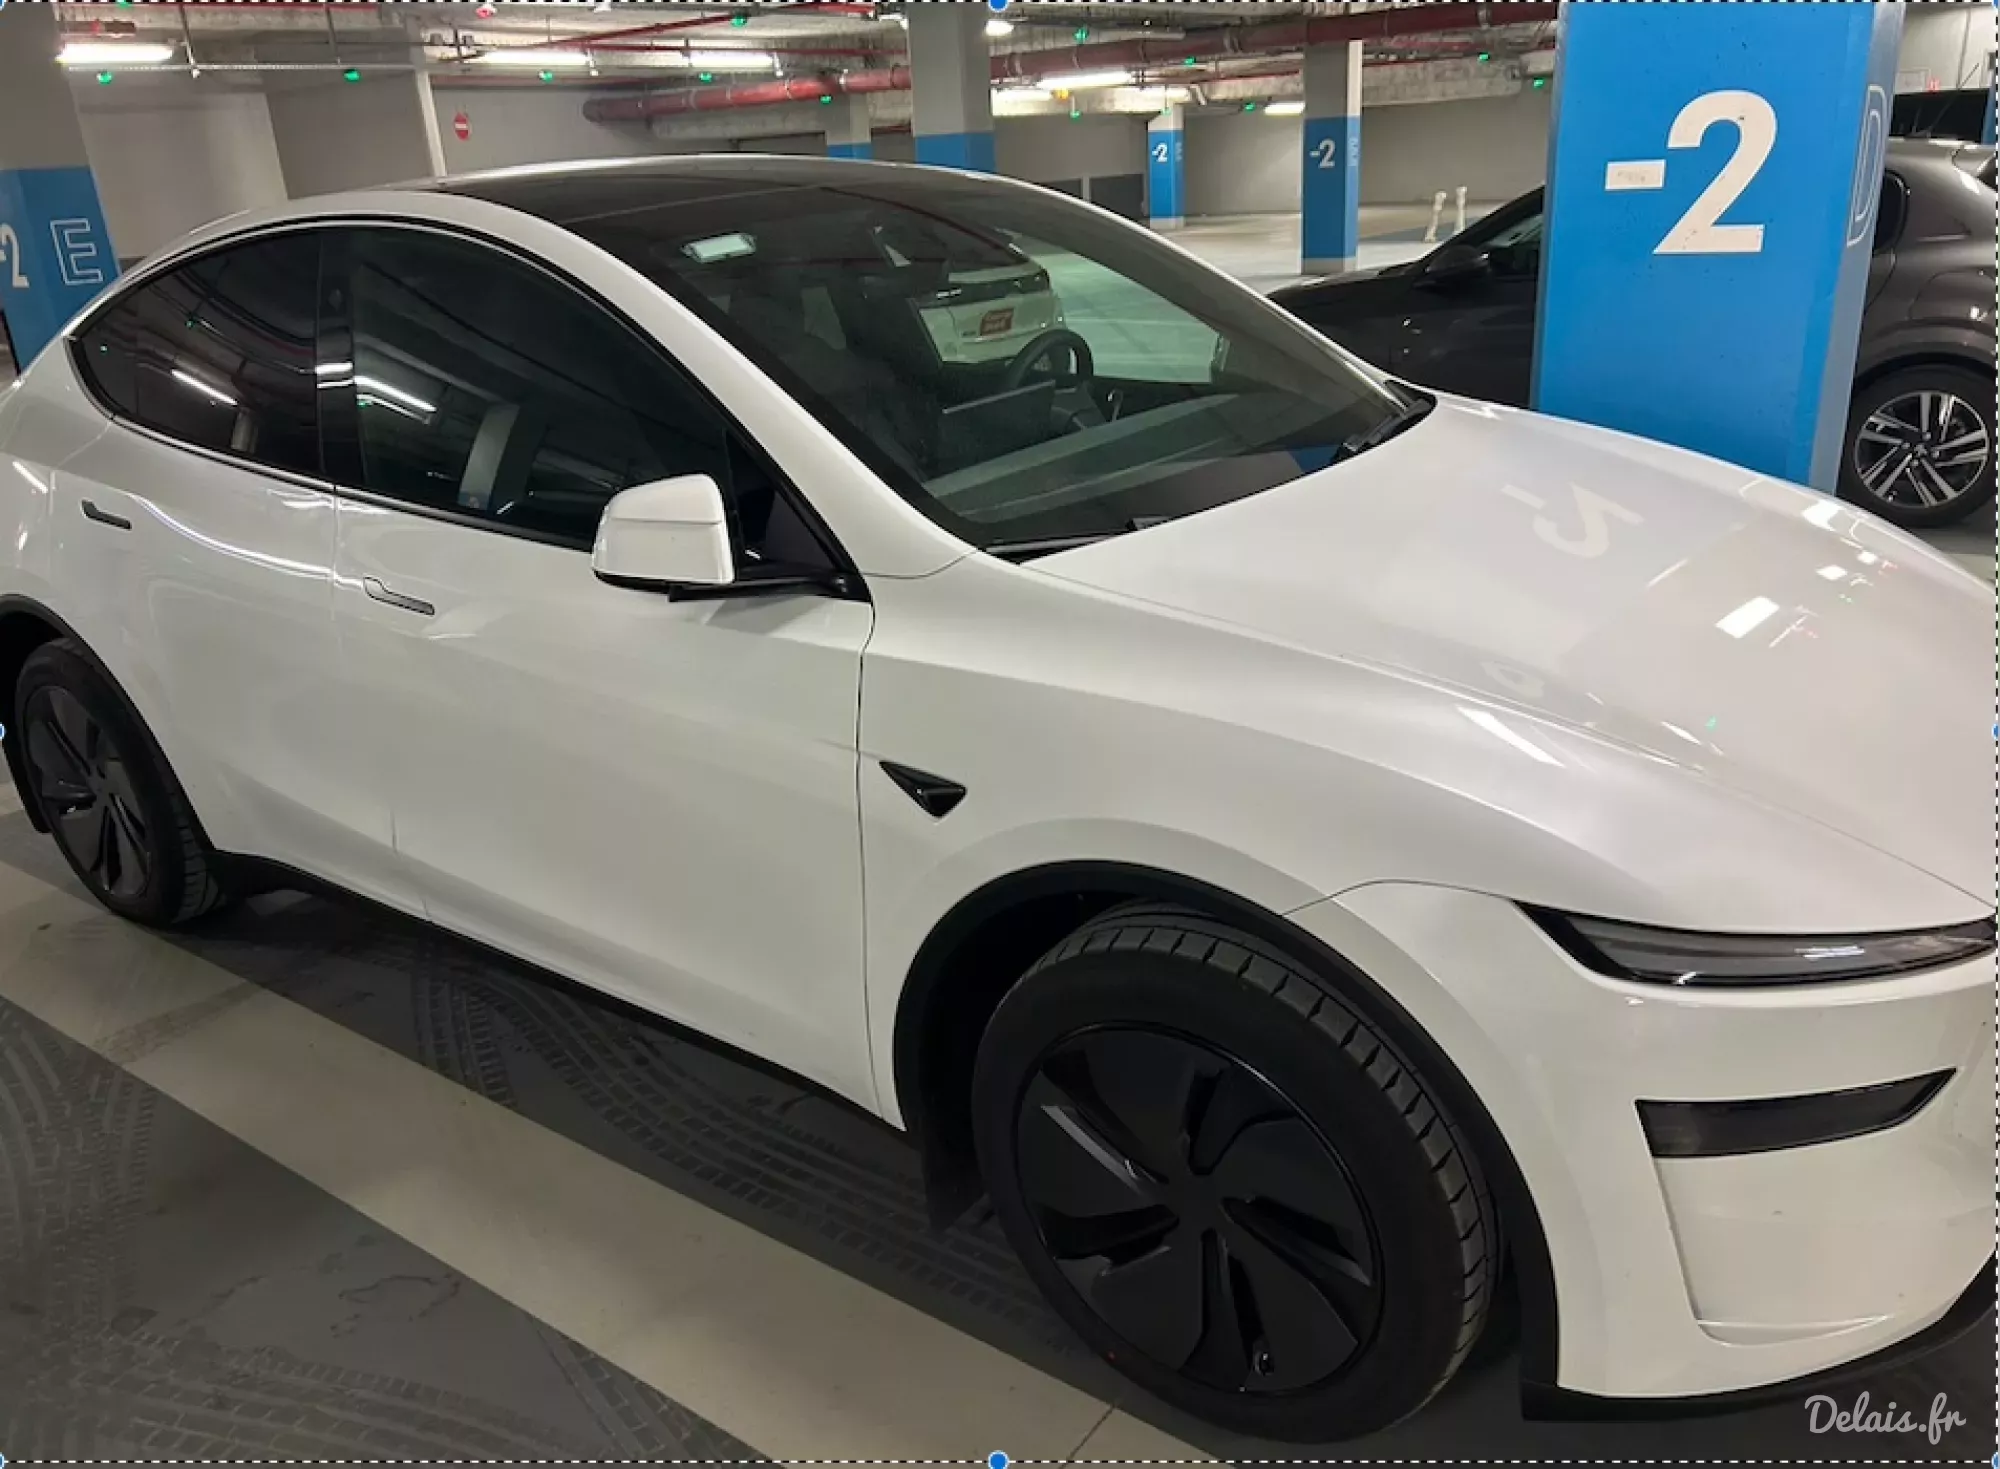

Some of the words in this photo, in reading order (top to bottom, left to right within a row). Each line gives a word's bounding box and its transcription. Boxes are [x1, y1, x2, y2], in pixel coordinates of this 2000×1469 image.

[1151, 142, 1168, 163] -2
[1309, 138, 1336, 169] -2
[1605, 90, 1778, 254] -2
[50, 217, 103, 286] E
